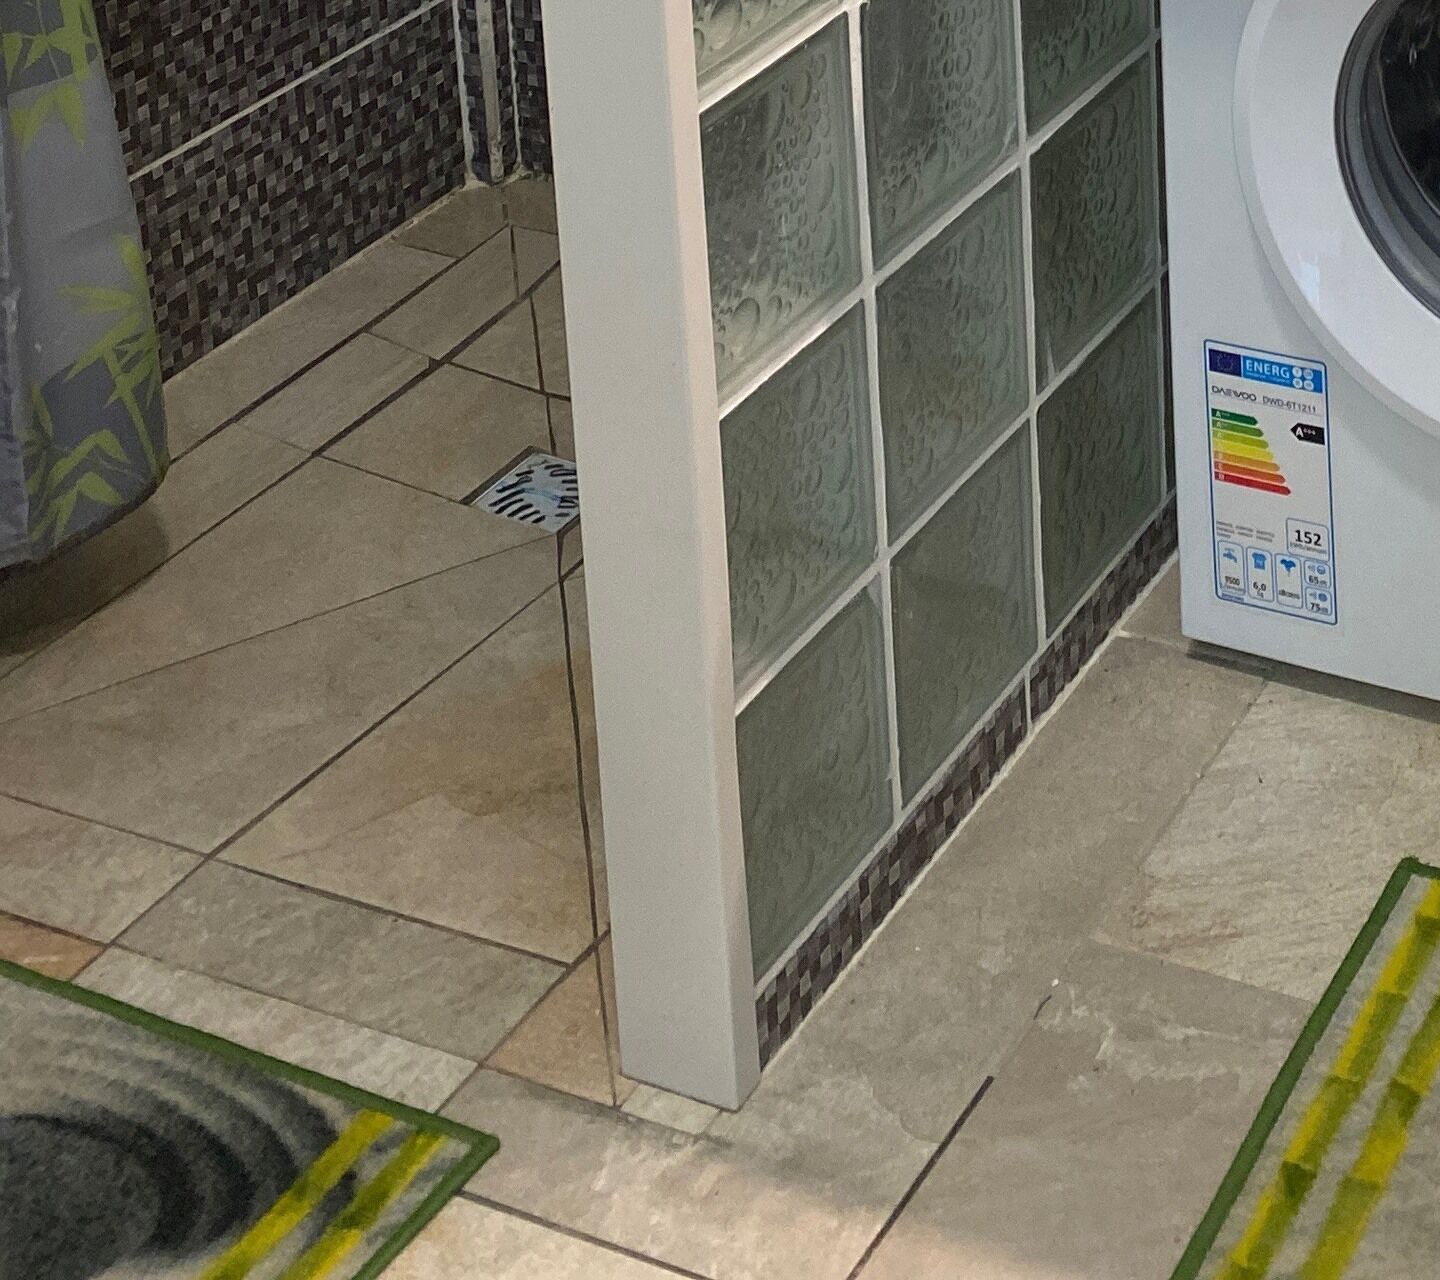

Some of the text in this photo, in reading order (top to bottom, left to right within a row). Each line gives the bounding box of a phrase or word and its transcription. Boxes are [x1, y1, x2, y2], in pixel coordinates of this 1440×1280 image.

[1245, 359, 1290, 379] ENERG
[1211, 384, 1257, 402] DAEWOO
[1294, 529, 1322, 547] 152
